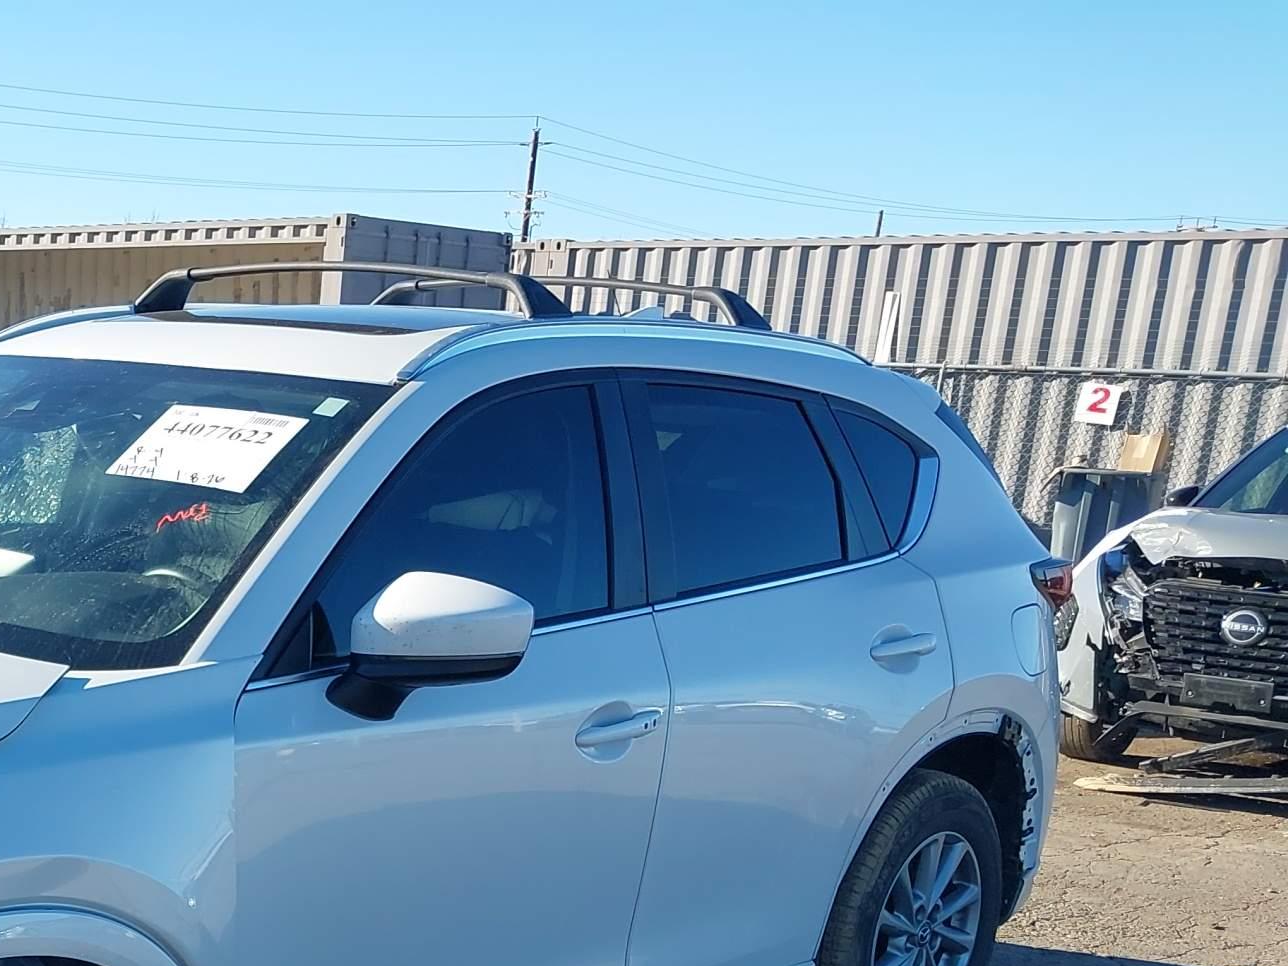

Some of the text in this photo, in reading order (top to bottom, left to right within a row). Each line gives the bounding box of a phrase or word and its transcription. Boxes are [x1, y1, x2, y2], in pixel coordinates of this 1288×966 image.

[1086, 387, 1111, 414] 2
[163, 421, 273, 445] 44077622
[1221, 621, 1265, 633] NISSAN
